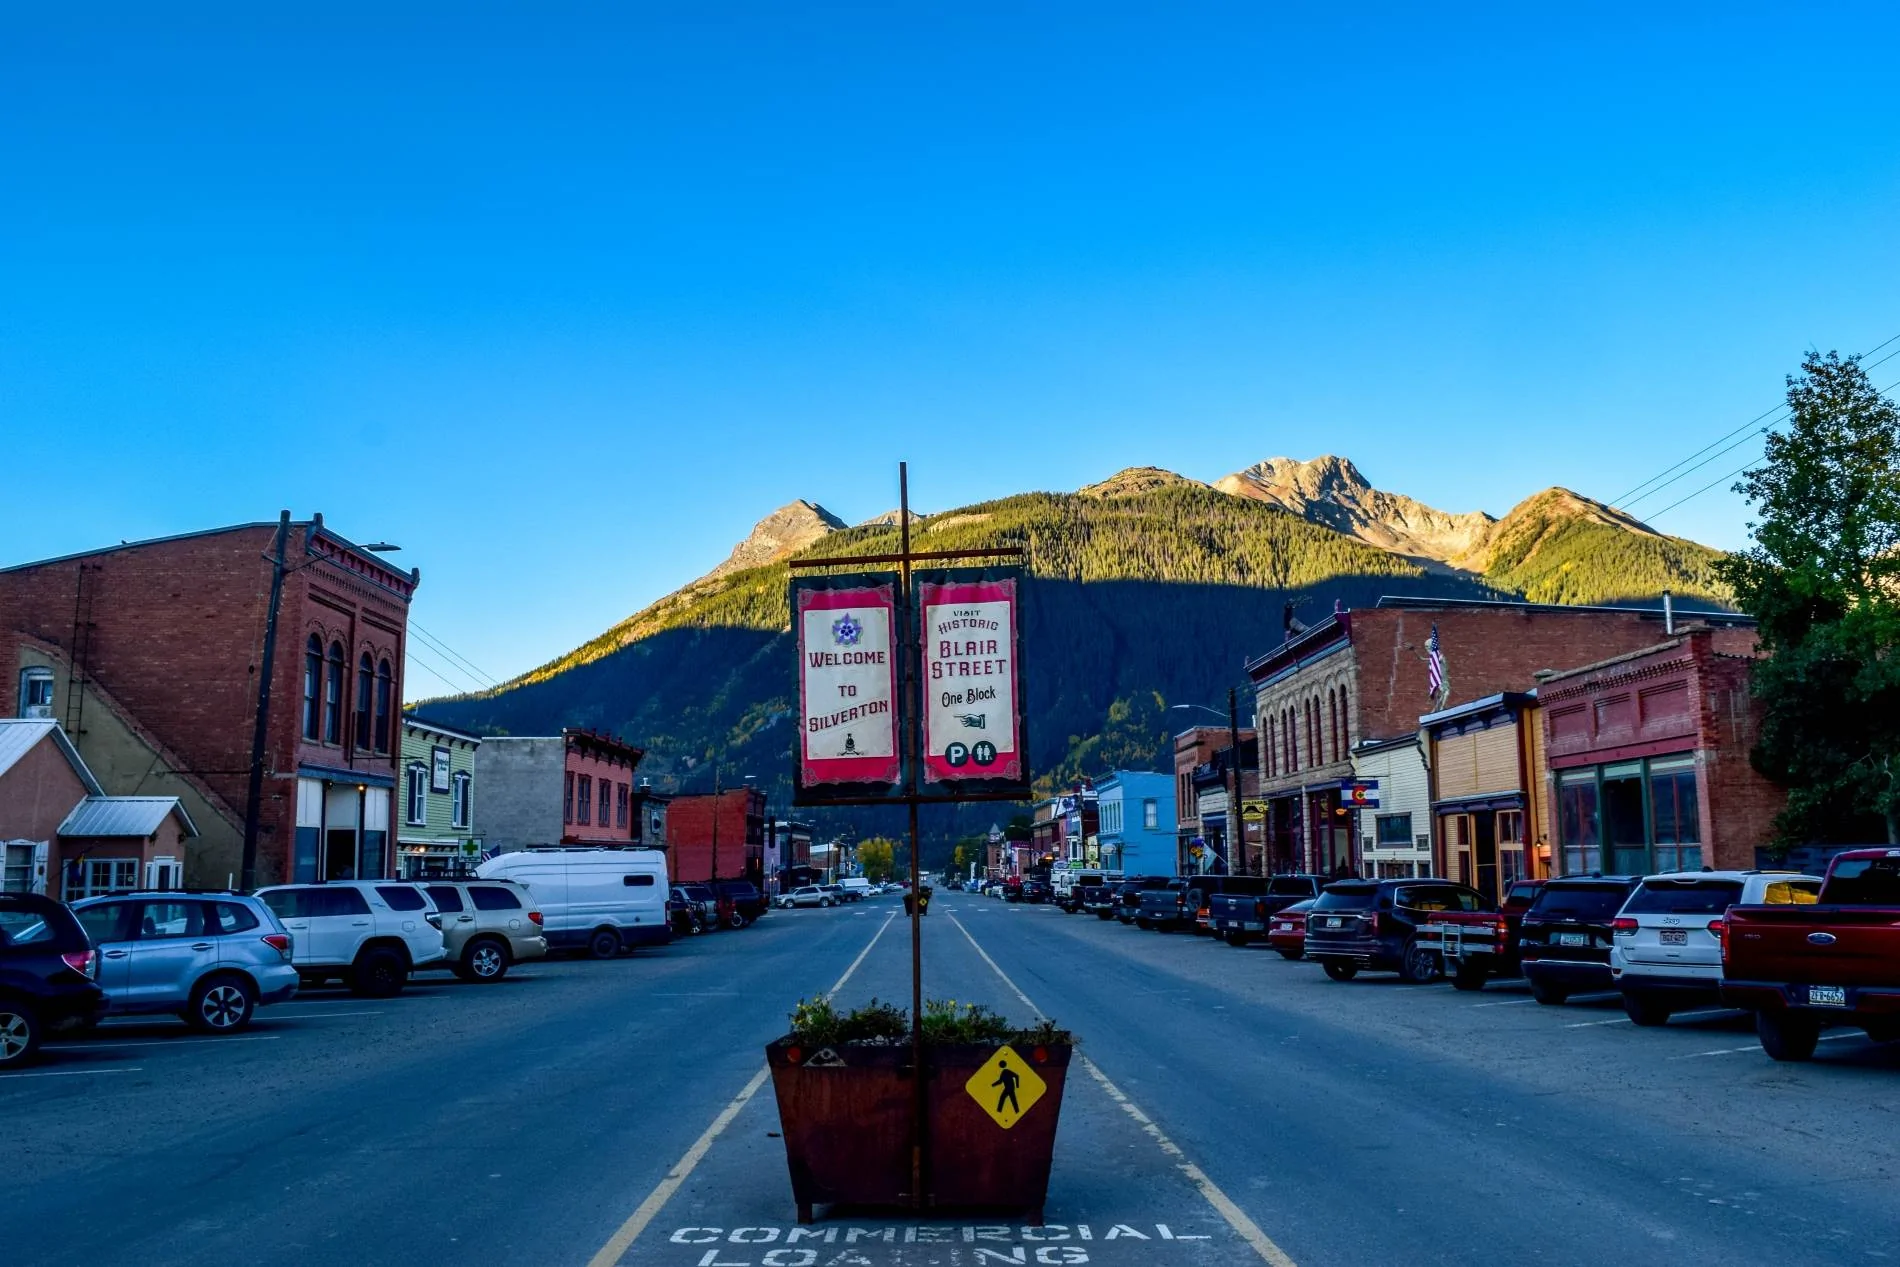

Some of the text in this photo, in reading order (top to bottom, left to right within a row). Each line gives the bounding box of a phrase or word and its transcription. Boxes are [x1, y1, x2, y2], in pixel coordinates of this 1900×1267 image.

[938, 618, 999, 635] HISTORIC
[940, 640, 997, 659] BLAIR
[808, 651, 886, 668] WELCOME
[931, 659, 1007, 679] STREET
[838, 685, 857, 697] TO
[941, 685, 997, 708] One Block
[808, 700, 888, 732] SILVERTON
[669, 1224, 1212, 1245] COMMERCIAL
